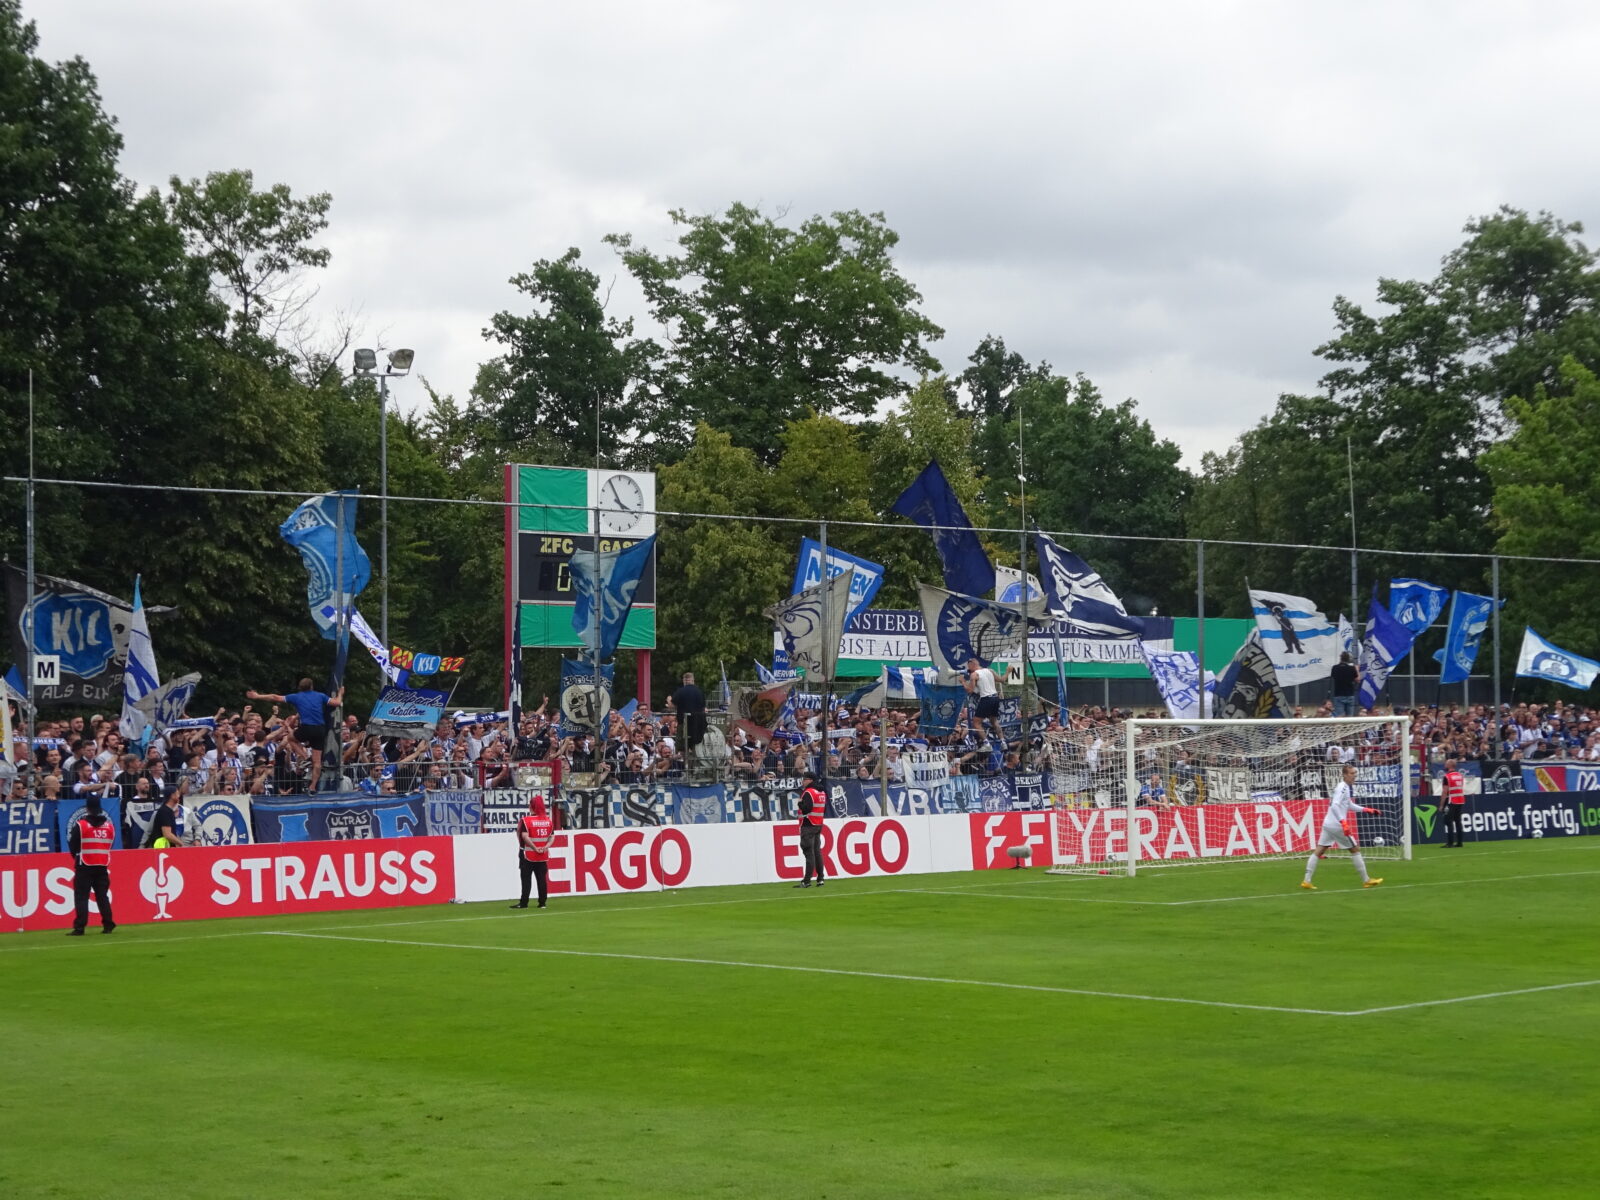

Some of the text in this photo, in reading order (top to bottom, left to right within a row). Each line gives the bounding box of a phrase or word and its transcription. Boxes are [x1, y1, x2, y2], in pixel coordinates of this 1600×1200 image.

[540, 537, 573, 554] ZFC
[600, 540, 637, 553] GAS
[881, 641, 931, 657] ALLE
[1100, 643, 1141, 660] IMME
[37, 661, 55, 679] M
[1011, 666, 1021, 680] N
[331, 816, 368, 826] ULTRAS
[429, 803, 481, 825] UNS
[1445, 807, 1522, 837] eenet,
[1523, 803, 1579, 835] fertig,
[211, 850, 437, 906] STRAUSS
